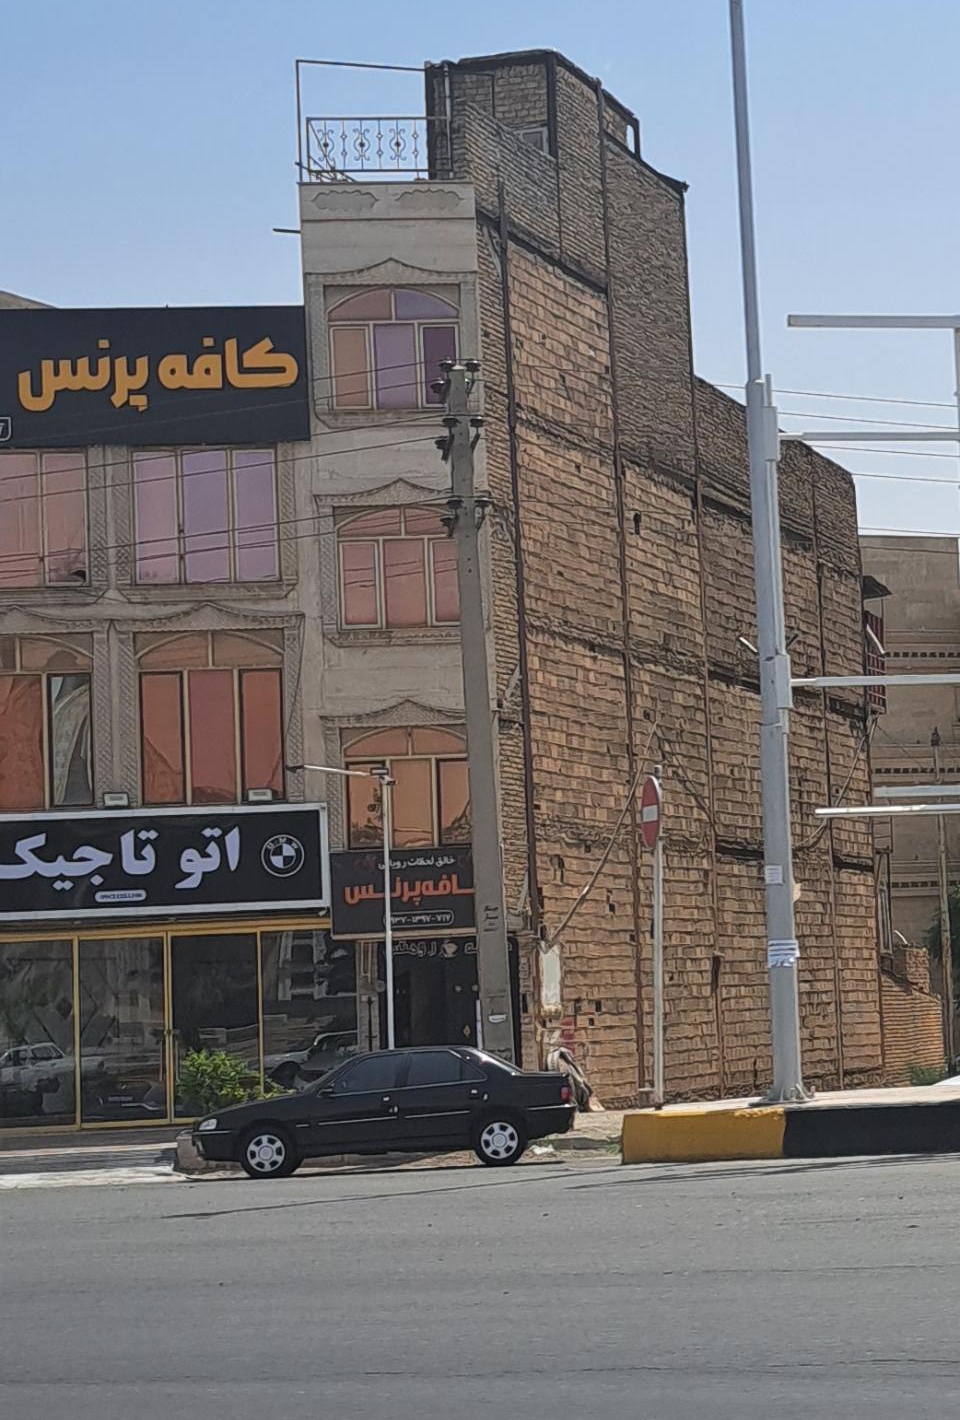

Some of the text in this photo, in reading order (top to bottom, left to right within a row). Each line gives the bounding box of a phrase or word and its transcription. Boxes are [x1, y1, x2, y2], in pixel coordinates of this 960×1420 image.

[18, 337, 299, 412] کافه پرنس
[0, 825, 242, 891] اتو تاجیک
[420, 872, 476, 897] افه
